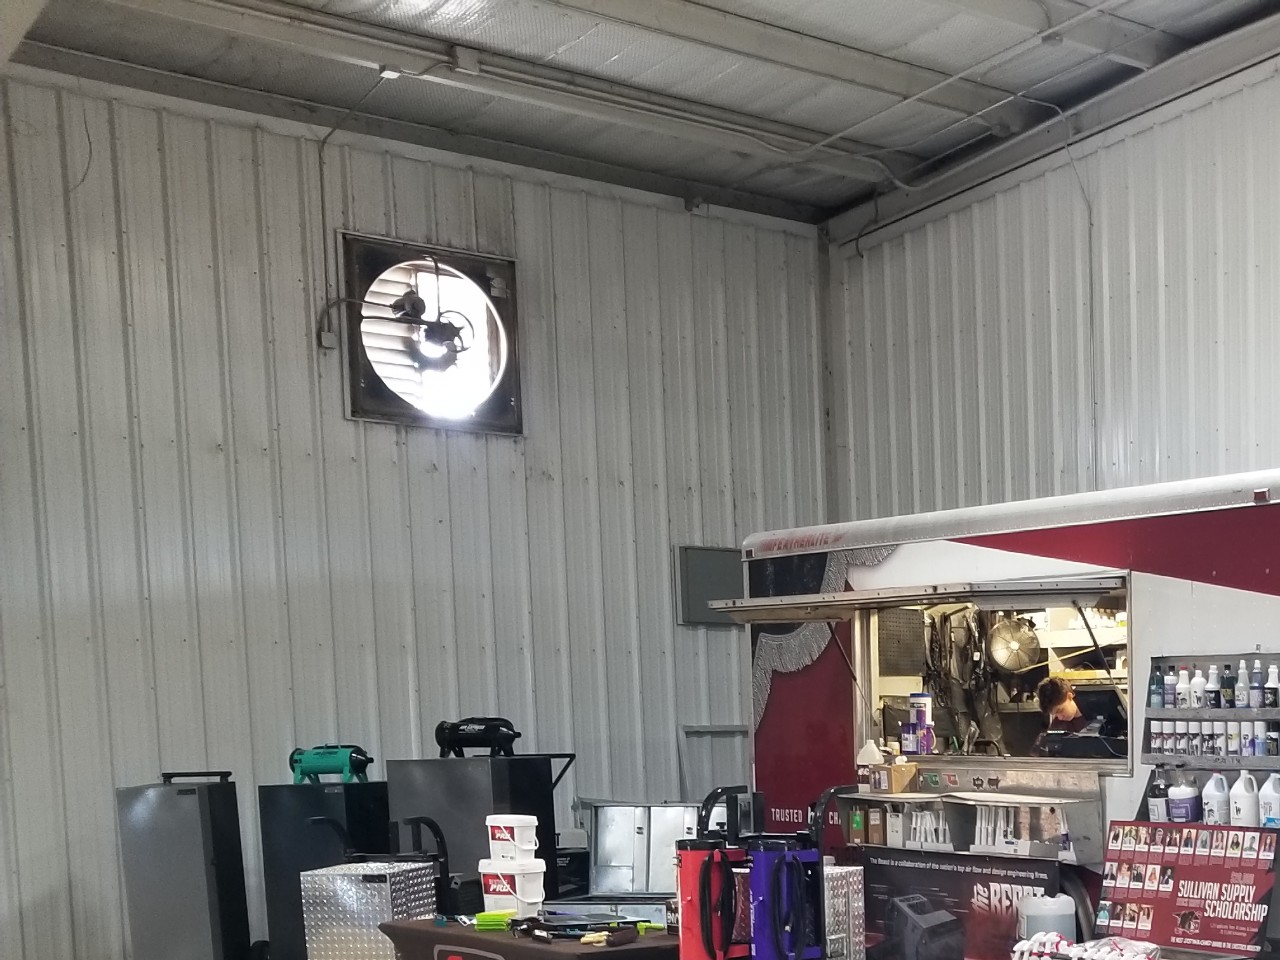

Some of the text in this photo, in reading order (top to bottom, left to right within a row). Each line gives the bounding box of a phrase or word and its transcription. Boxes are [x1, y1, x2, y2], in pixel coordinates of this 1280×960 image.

[771, 808, 803, 823] TRUSTED
[898, 859, 926, 869] collaboration
[1178, 880, 1220, 899] SULLIVAN
[1221, 883, 1256, 903] SUPPLY
[1204, 900, 1268, 922] SCHOLARSHIP
